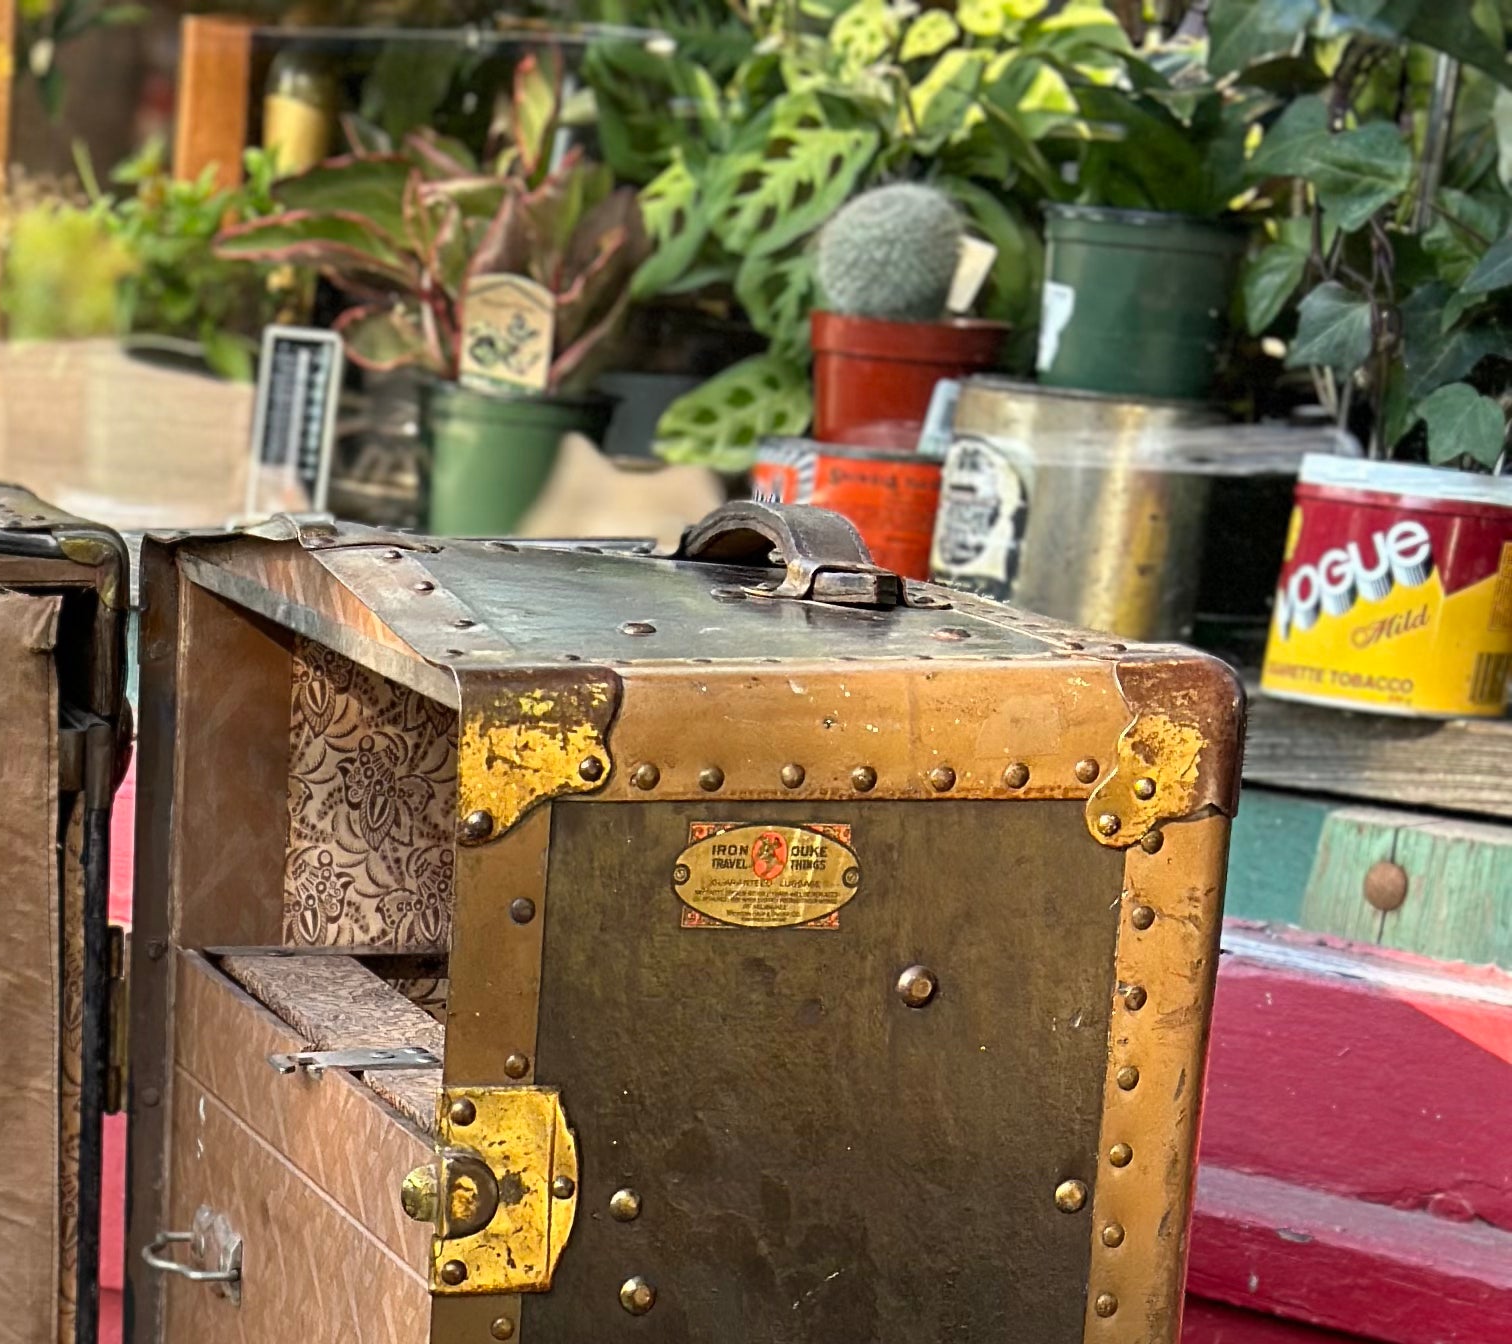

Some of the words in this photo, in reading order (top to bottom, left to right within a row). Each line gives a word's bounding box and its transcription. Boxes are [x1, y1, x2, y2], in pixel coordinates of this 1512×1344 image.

[1351, 604, 1431, 649] Mild
[1331, 670, 1414, 694] TOBACCO
[711, 844, 750, 857] IRON
[790, 845, 829, 858] DUKE
[711, 858, 749, 870] TRAVEL
[790, 859, 827, 871] THINGS
